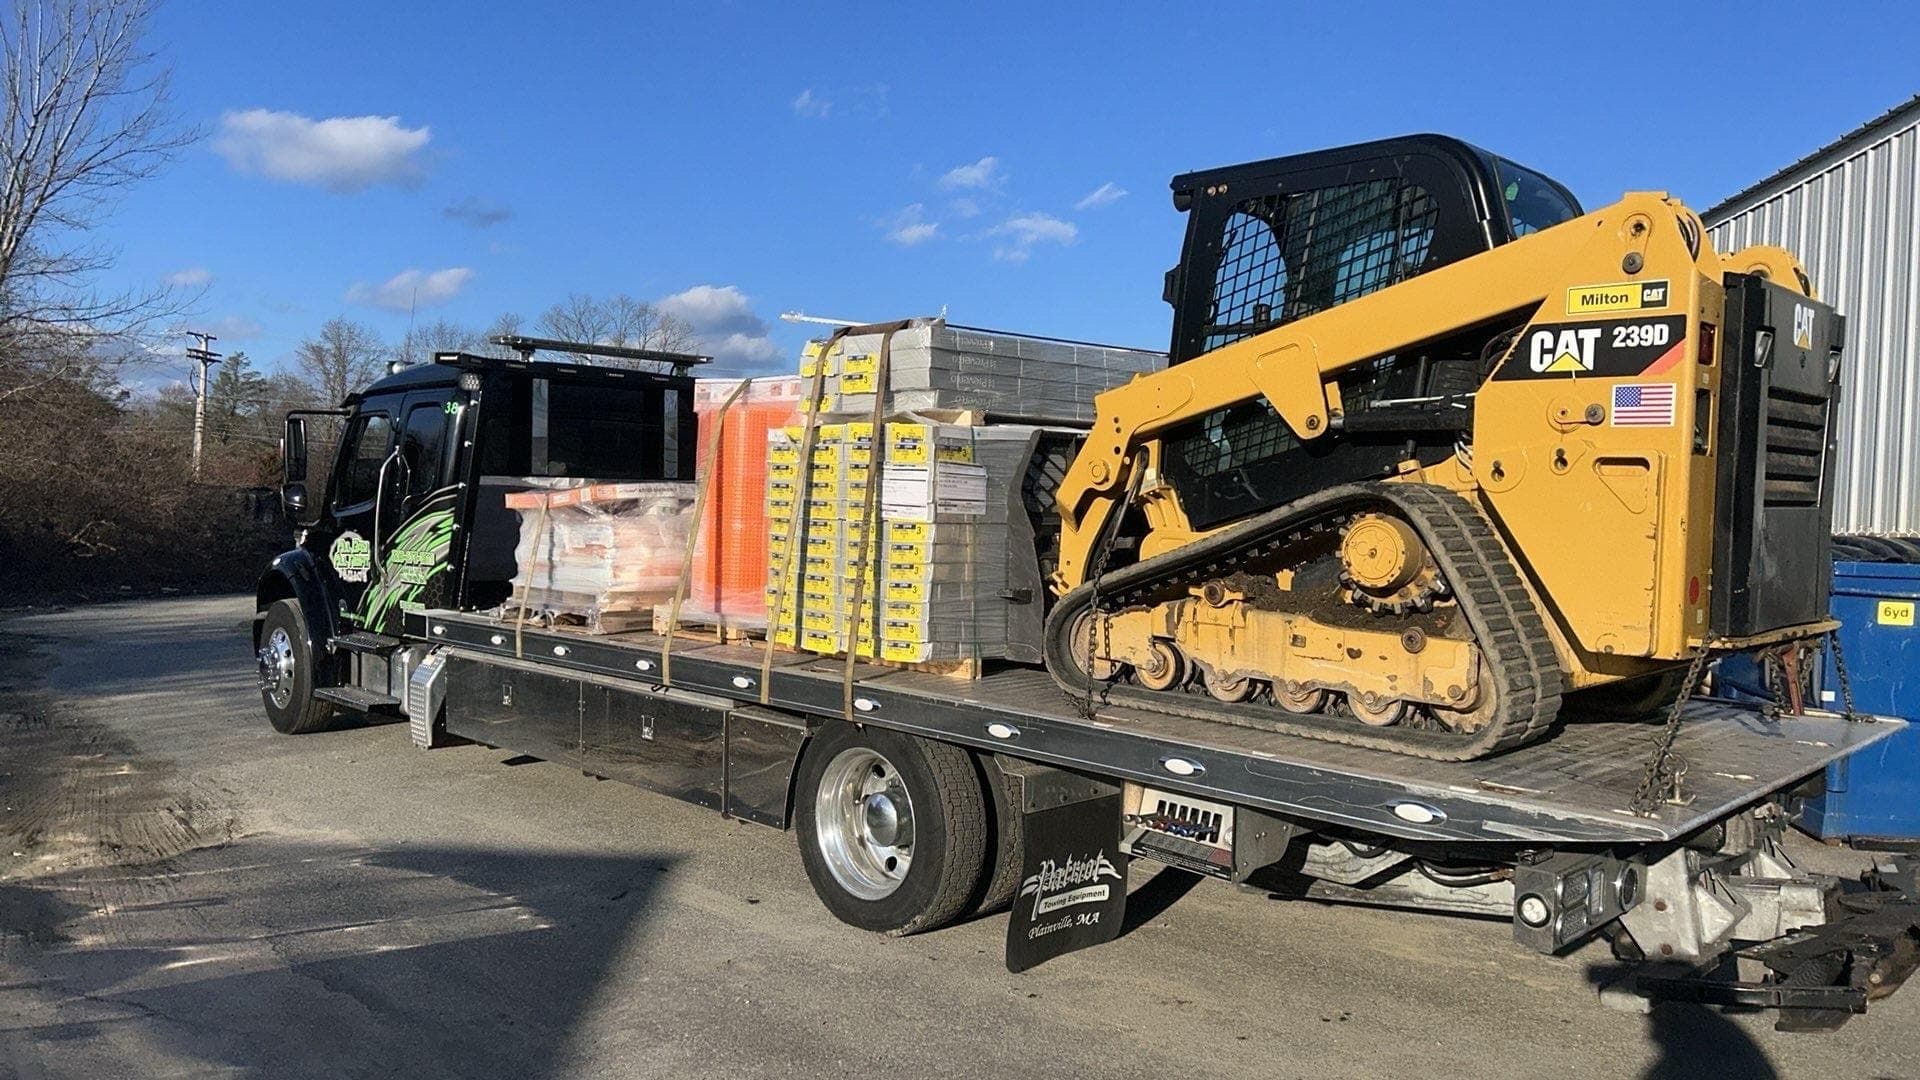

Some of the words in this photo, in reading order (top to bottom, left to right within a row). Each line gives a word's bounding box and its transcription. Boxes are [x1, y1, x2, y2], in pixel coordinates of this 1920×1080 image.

[1580, 291, 1629, 306] Milton
[1642, 287, 1665, 302] CAT
[1793, 303, 1815, 350] CAT
[1529, 328, 1601, 373] CAT
[1612, 323, 1669, 348] 239D
[444, 401, 459, 414] 38
[1884, 606, 1909, 619] 6yd
[1043, 898, 1066, 909] Towing
[1068, 890, 1106, 903] Equipment
[1076, 912, 1100, 926] MA
